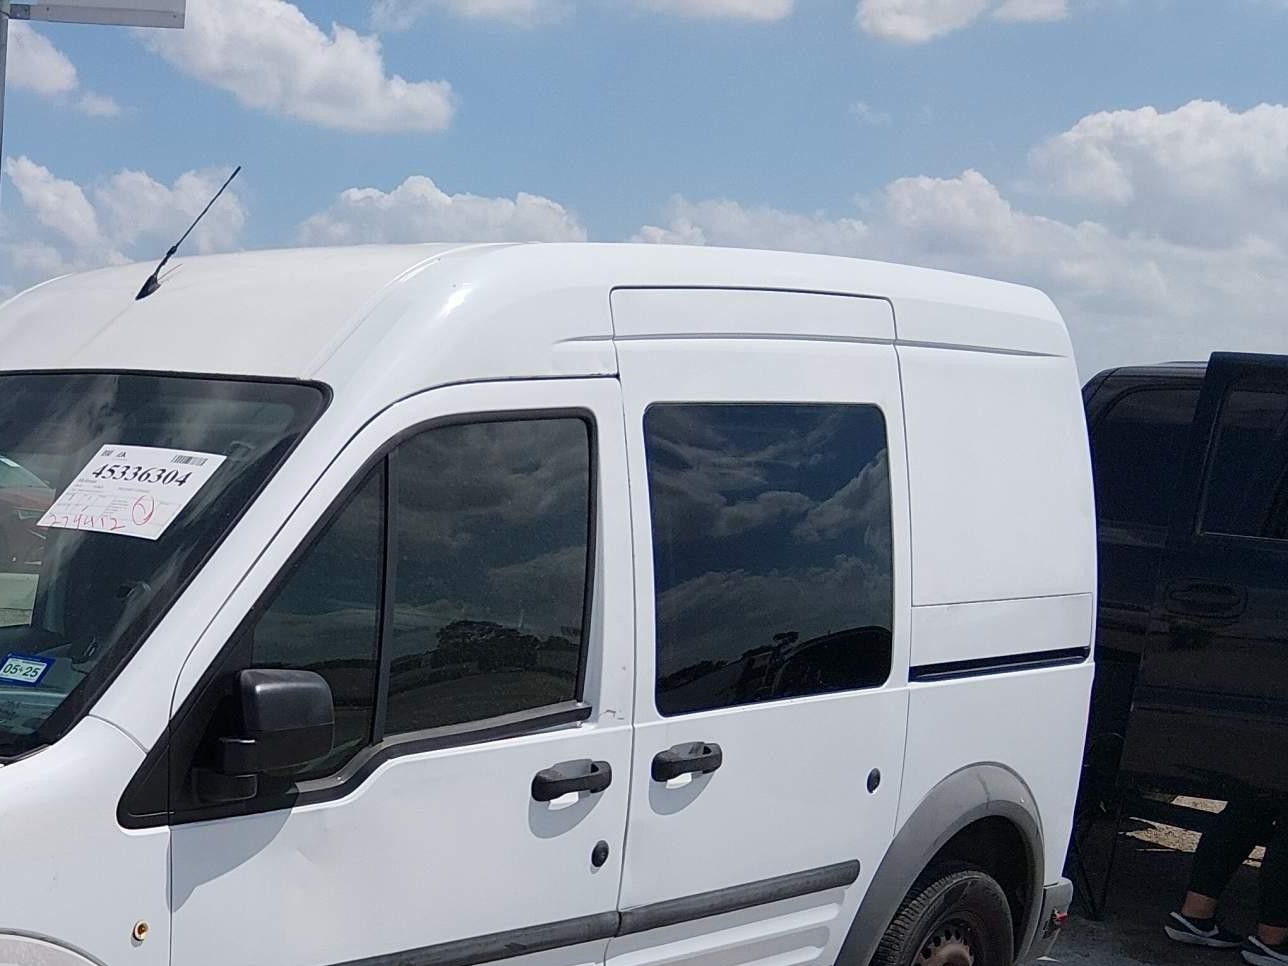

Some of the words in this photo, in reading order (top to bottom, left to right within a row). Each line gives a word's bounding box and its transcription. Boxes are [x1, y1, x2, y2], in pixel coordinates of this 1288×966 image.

[92, 463, 193, 487] 45336304
[3, 663, 20, 675] 05
[22, 666, 41, 678] 25
